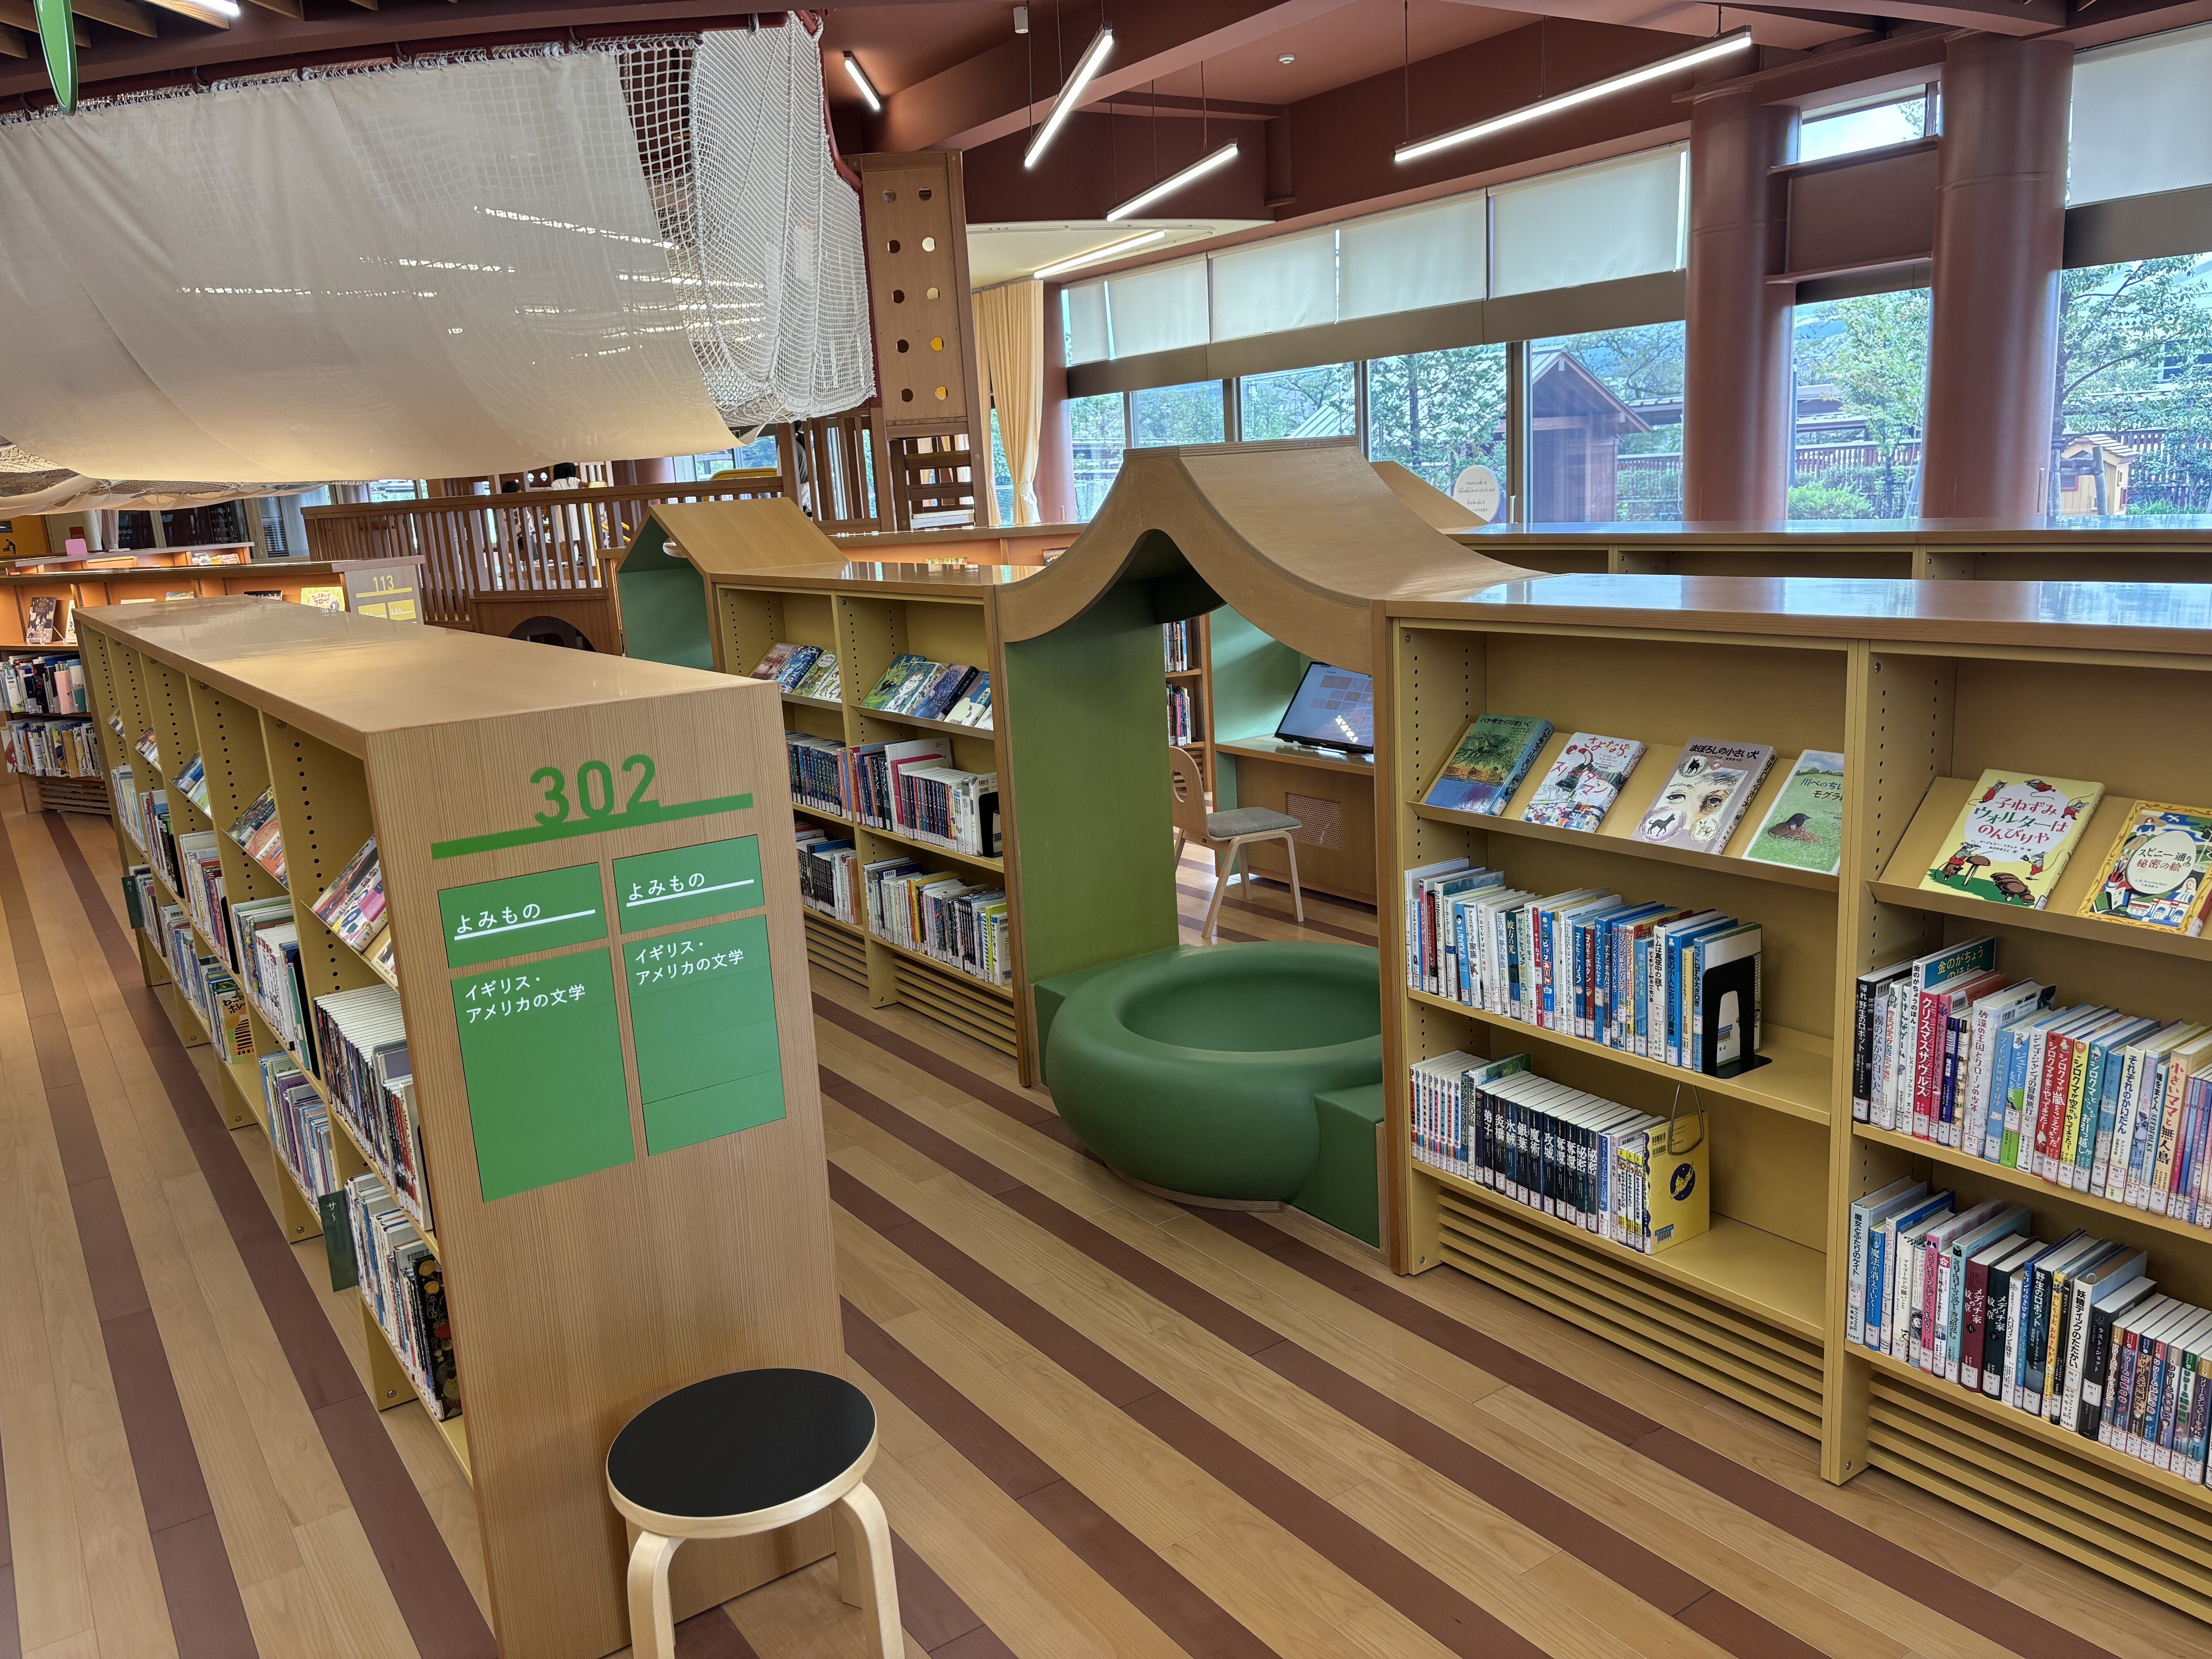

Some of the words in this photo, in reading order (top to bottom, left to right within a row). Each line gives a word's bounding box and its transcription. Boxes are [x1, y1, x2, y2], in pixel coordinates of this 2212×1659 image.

[373, 575, 394, 591] 113
[1480, 717, 1532, 727] ハヤ号セイ川をいく
[1689, 744, 1760, 760] まぼろしの小さい犬
[530, 754, 660, 826] 302
[1741, 754, 1776, 810] まぼろしの小さい犬
[1974, 807, 2068, 833] ウォルターは
[1996, 797, 2057, 815] 子ねずみ
[1978, 824, 2049, 844] のんびりや
[2136, 859, 2182, 872] 秘密の絵
[629, 872, 706, 902] よみもの
[457, 903, 541, 934] よみもの
[1507, 919, 1516, 954] 彼方の光
[636, 949, 744, 986] アメリカの文学
[1654, 933, 1663, 991] トムは真夜中の庭で
[1938, 946, 1983, 975] 金のがちょう
[466, 984, 586, 1023] アメリカの文学
[1667, 946, 1675, 1037] 灰色の小人たちと川の冒険
[1910, 964, 1922, 1024] 金のがちょうのほん
[1858, 1001, 1867, 1052] 野生のロボット
[1872, 1014, 1885, 1093] 霧のなかの白い犬
[1917, 996, 1932, 1098] クリスマスサウルス
[1970, 1010, 1989, 1112] 砂漠の王国とクローンの少年
[2007, 1070, 2016, 1100] 走る夏
[2016, 1051, 2027, 1089] ジェミーと
[2025, 1034, 2042, 1116] ジンゴ・ジャンゴの冒険旅行
[2117, 1055, 2138, 1135] それぞれのかいだん
[2152, 1073, 2163, 1111] 種をまく人
[1484, 1109, 1493, 1135] 弟子
[2147, 1113, 2157, 1153] SEEDFOLKS
[2157, 1063, 2184, 1165] 小さいママと無人島
[1530, 1127, 1540, 1156] 魔術
[1544, 1132, 1554, 1161] 攻城
[1853, 1213, 1862, 1276] 魔女とふたりのケイト
[1972, 1288, 1984, 1324] メディチ家
[1995, 1295, 2007, 1331] メディチ家
[2033, 1270, 2046, 1328] 野生のロボット
[2069, 1289, 2087, 1369] 妖精ディックのたたかい
[2094, 1327, 2103, 1372] ラスト・ショット
